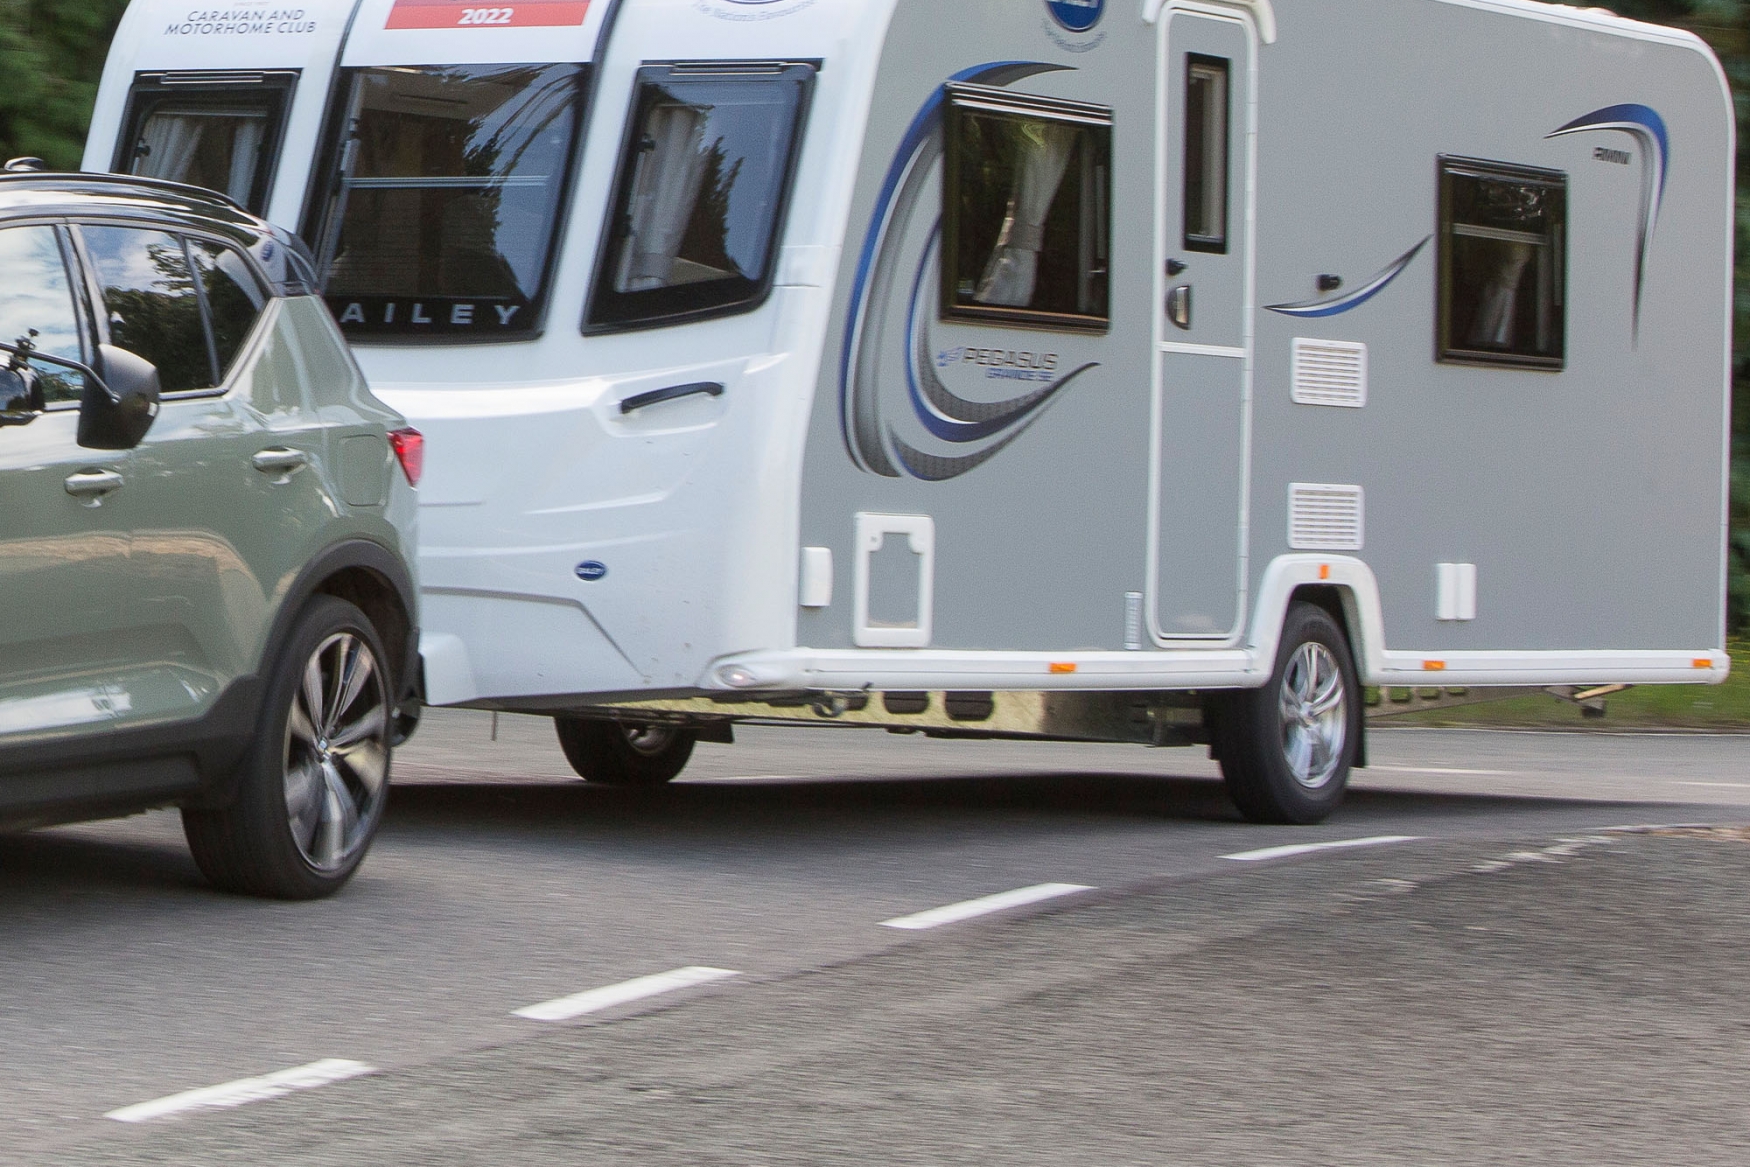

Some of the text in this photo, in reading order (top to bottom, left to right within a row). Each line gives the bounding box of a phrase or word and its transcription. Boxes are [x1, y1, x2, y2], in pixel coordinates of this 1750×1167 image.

[187, 9, 305, 22] CARAVAN AND
[457, 8, 514, 25] 2022
[165, 21, 316, 35] MOTORHOME CLUB
[340, 302, 520, 325] AILEY
[962, 347, 1058, 370] PEGASUS
